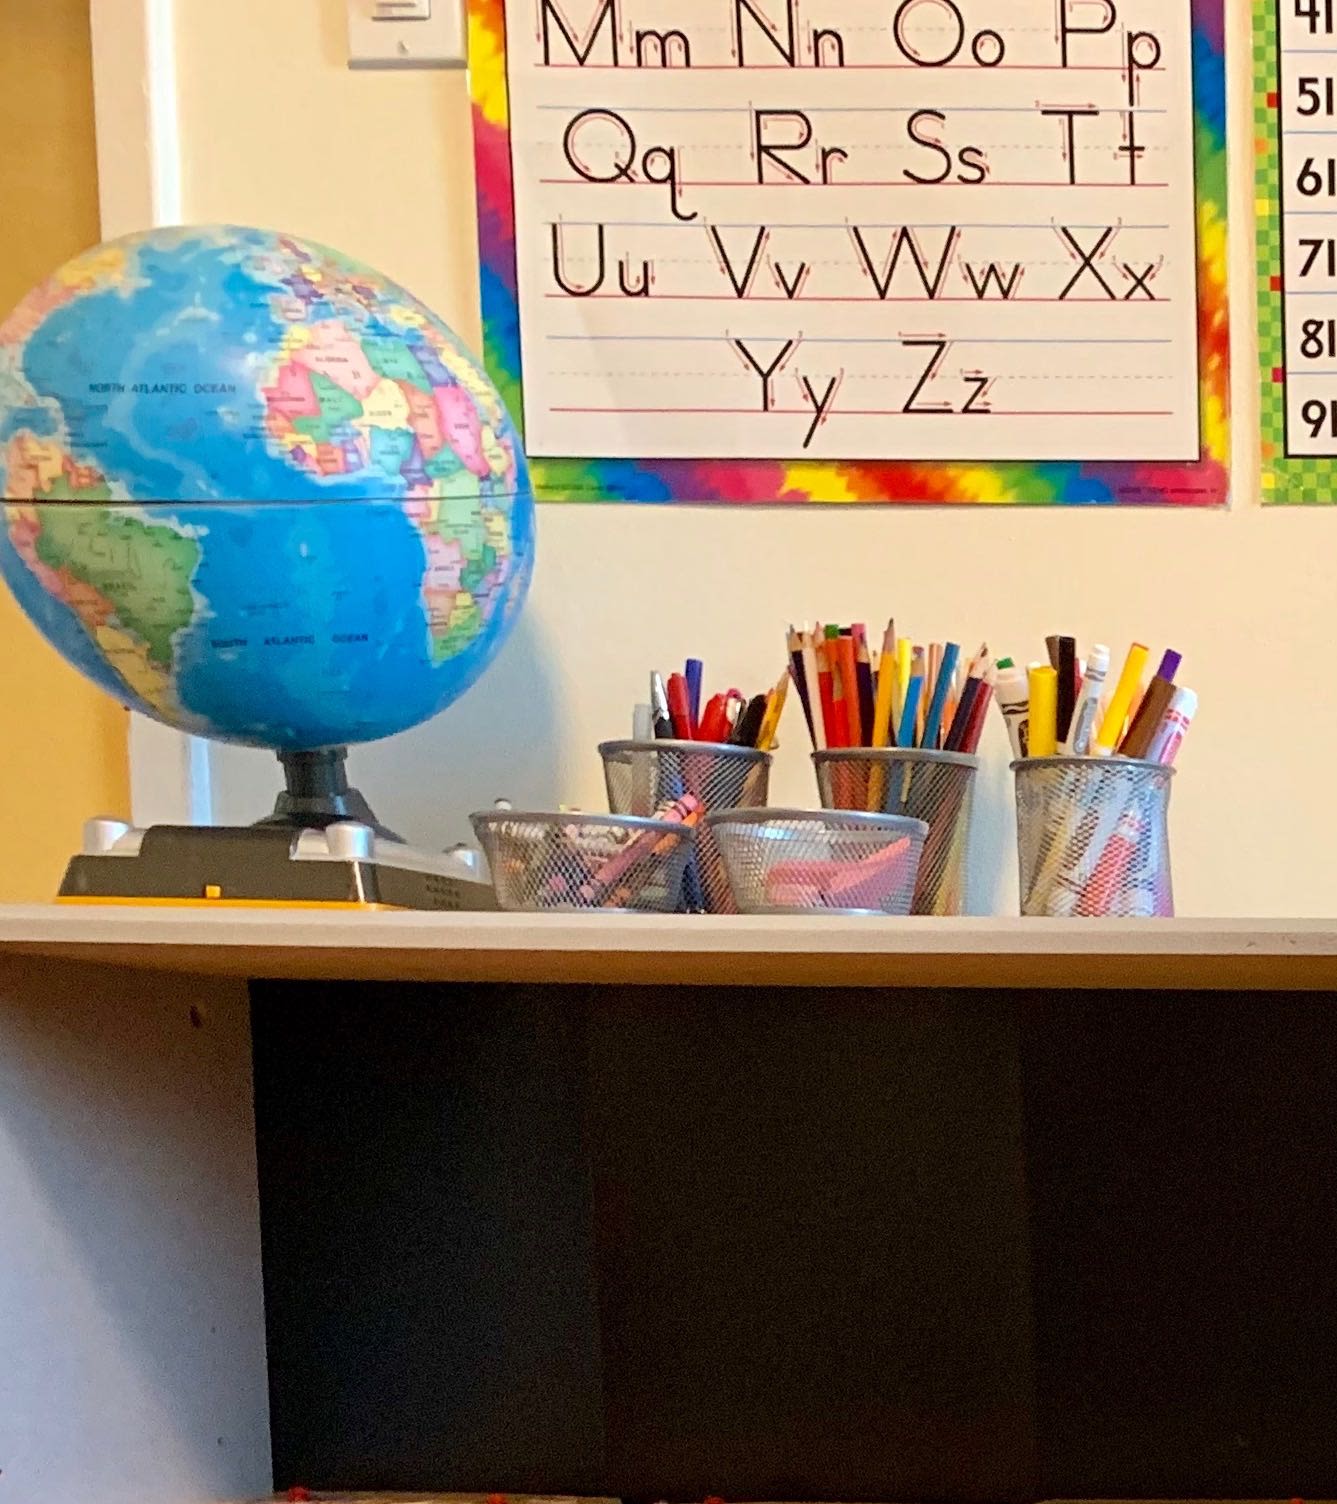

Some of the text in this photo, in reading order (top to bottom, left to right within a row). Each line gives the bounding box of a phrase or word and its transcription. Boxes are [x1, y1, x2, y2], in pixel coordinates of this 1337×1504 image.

[1295, 0, 1332, 33] 41
[1297, 78, 1333, 115] 51
[563, 108, 1146, 221] Qq Rr Ss Tt
[1297, 159, 1335, 195] 61
[551, 222, 1157, 301] Uu Vv Ww Xx
[1299, 240, 1335, 276] 71
[1301, 320, 1335, 358] 81
[131, 383, 187, 394] ATLANTIC
[194, 383, 237, 393] OCEAN
[735, 338, 992, 449] Yy Zz
[1302, 400, 1337, 437] 91
[264, 635, 315, 646] ATLANTIC
[332, 633, 368, 644] OCEAN
